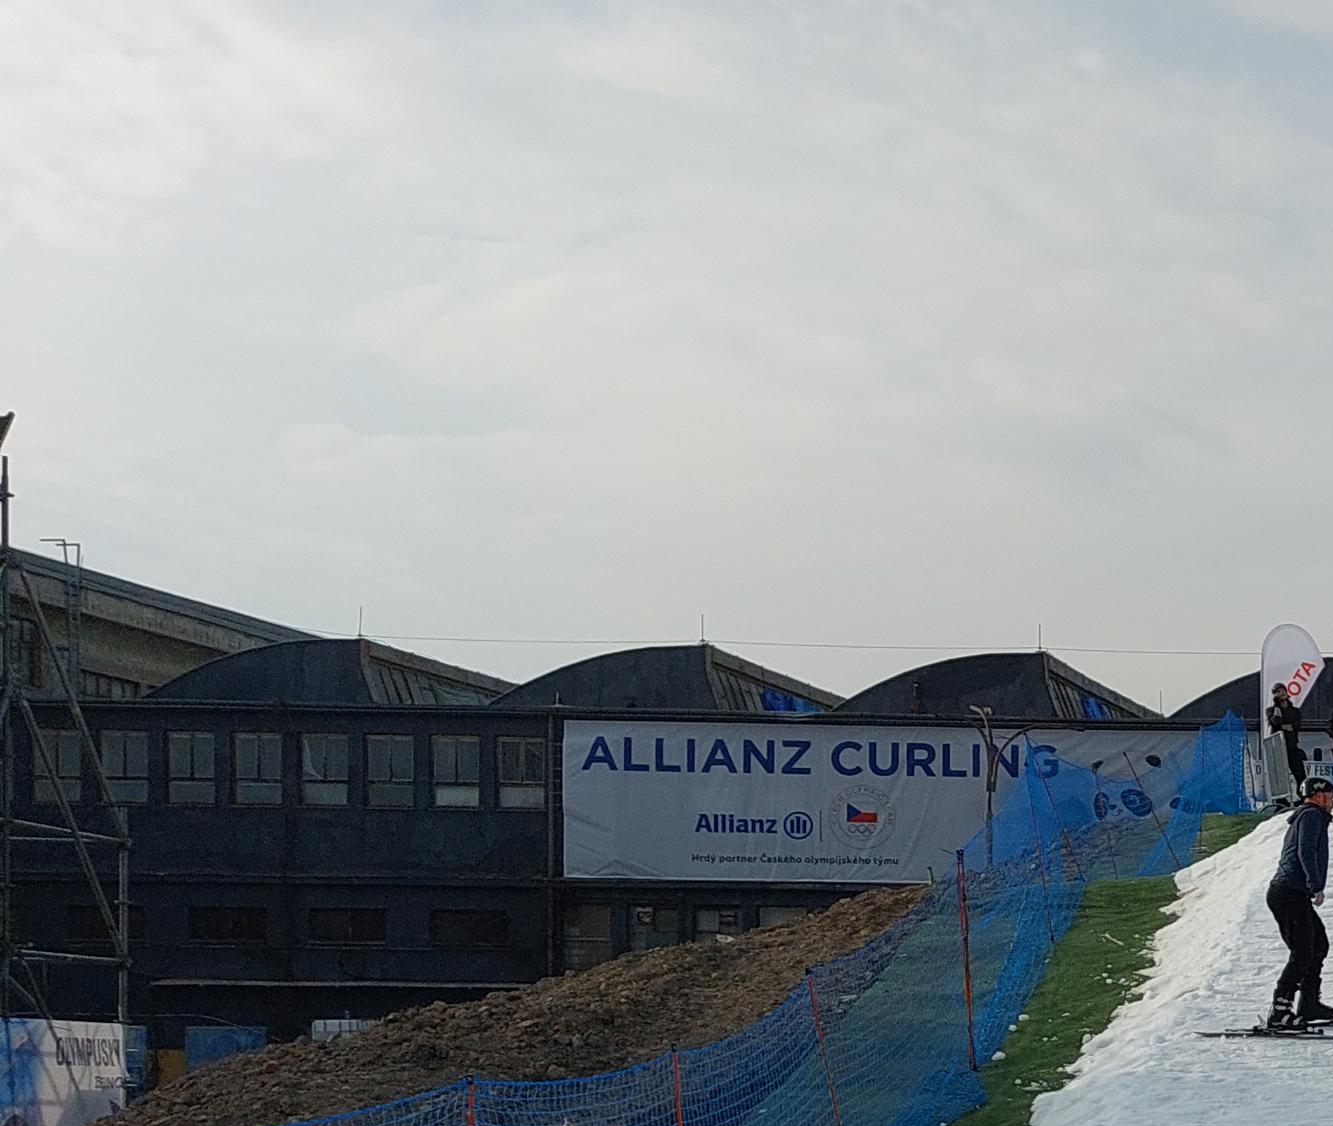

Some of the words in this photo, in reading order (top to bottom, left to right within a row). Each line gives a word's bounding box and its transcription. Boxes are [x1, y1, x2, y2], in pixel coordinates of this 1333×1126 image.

[1286, 661, 1317, 697] OTA
[581, 735, 812, 775] ALLIANZ
[831, 740, 1060, 779] CURLING
[695, 813, 778, 834] Allianz
[719, 854, 758, 864] partner
